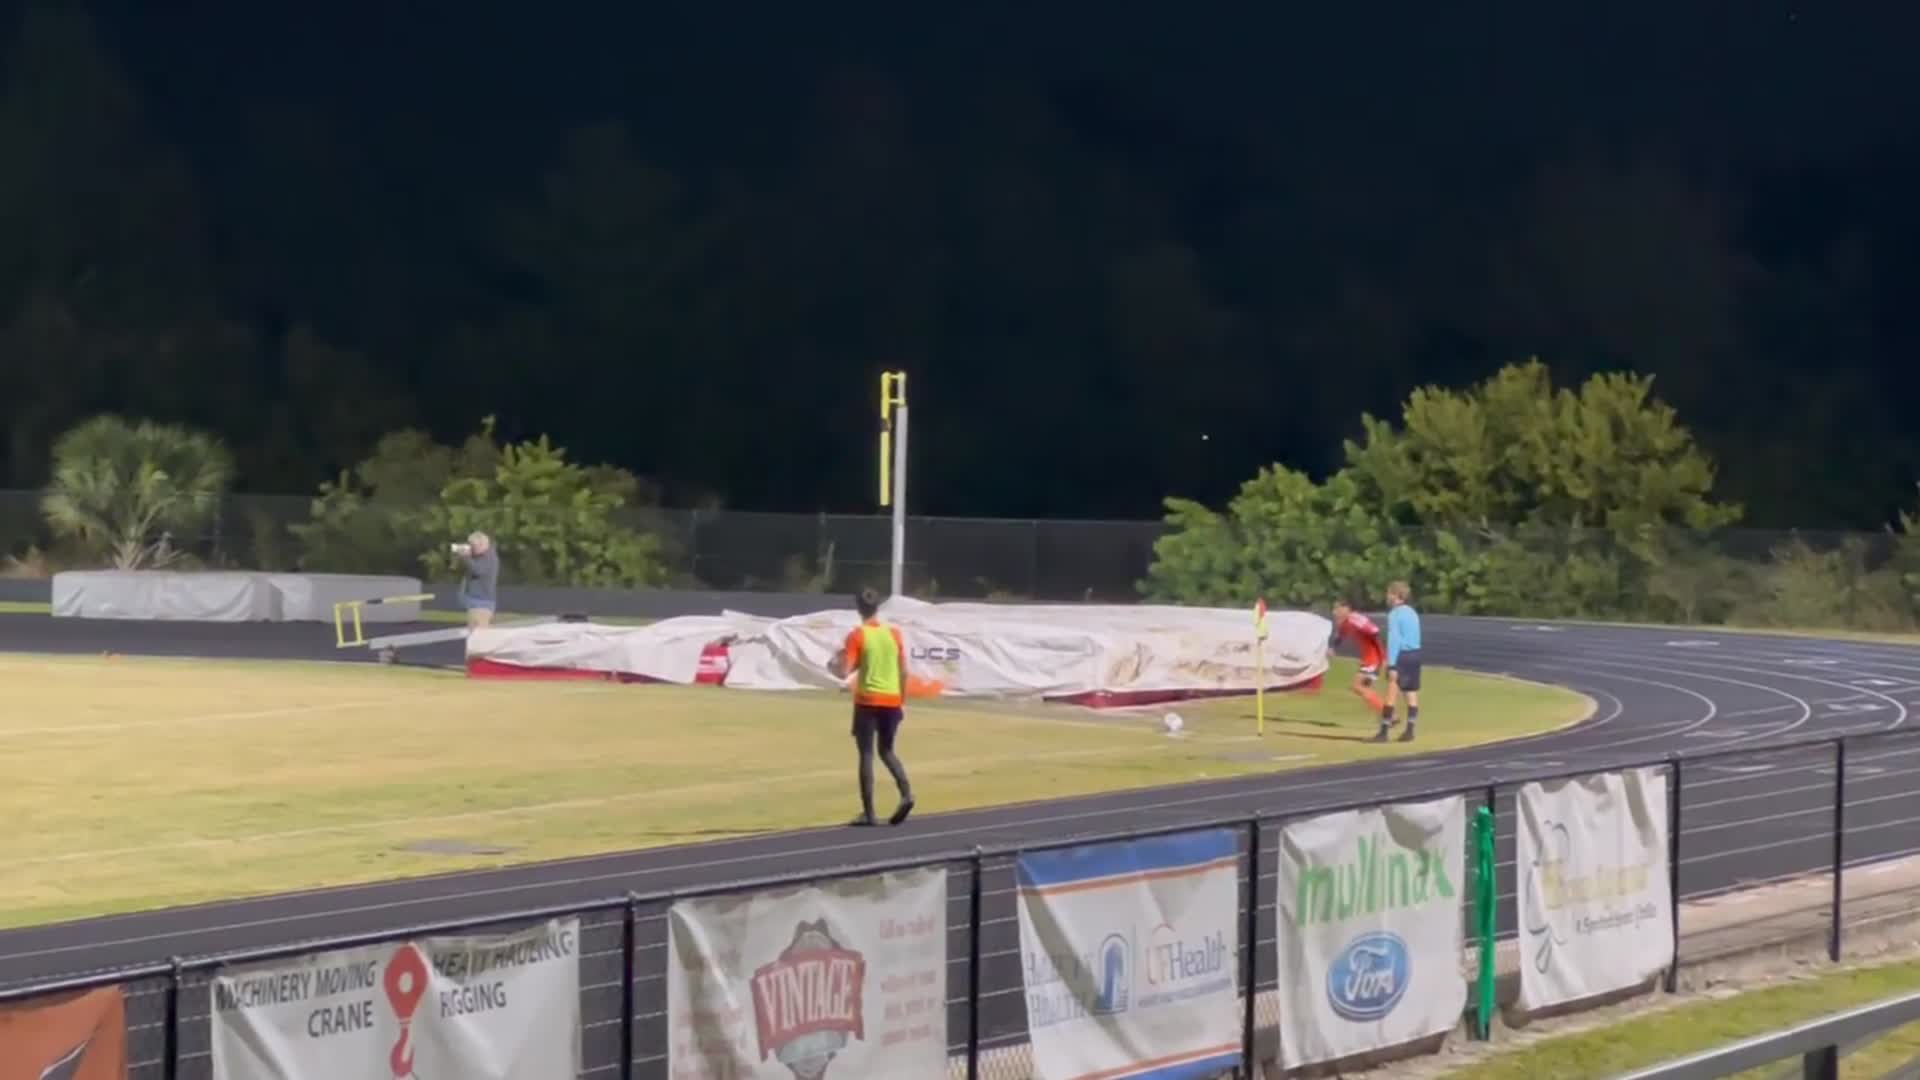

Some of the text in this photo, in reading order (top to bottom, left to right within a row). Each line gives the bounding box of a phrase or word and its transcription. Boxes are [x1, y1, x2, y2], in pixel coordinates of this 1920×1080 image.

[910, 647, 961, 660] UCS
[314, 960, 377, 997] MOVING
[1344, 946, 1396, 1001] Ford
[757, 957, 856, 1036] VINTAGE
[307, 1000, 374, 1038] CRANE
